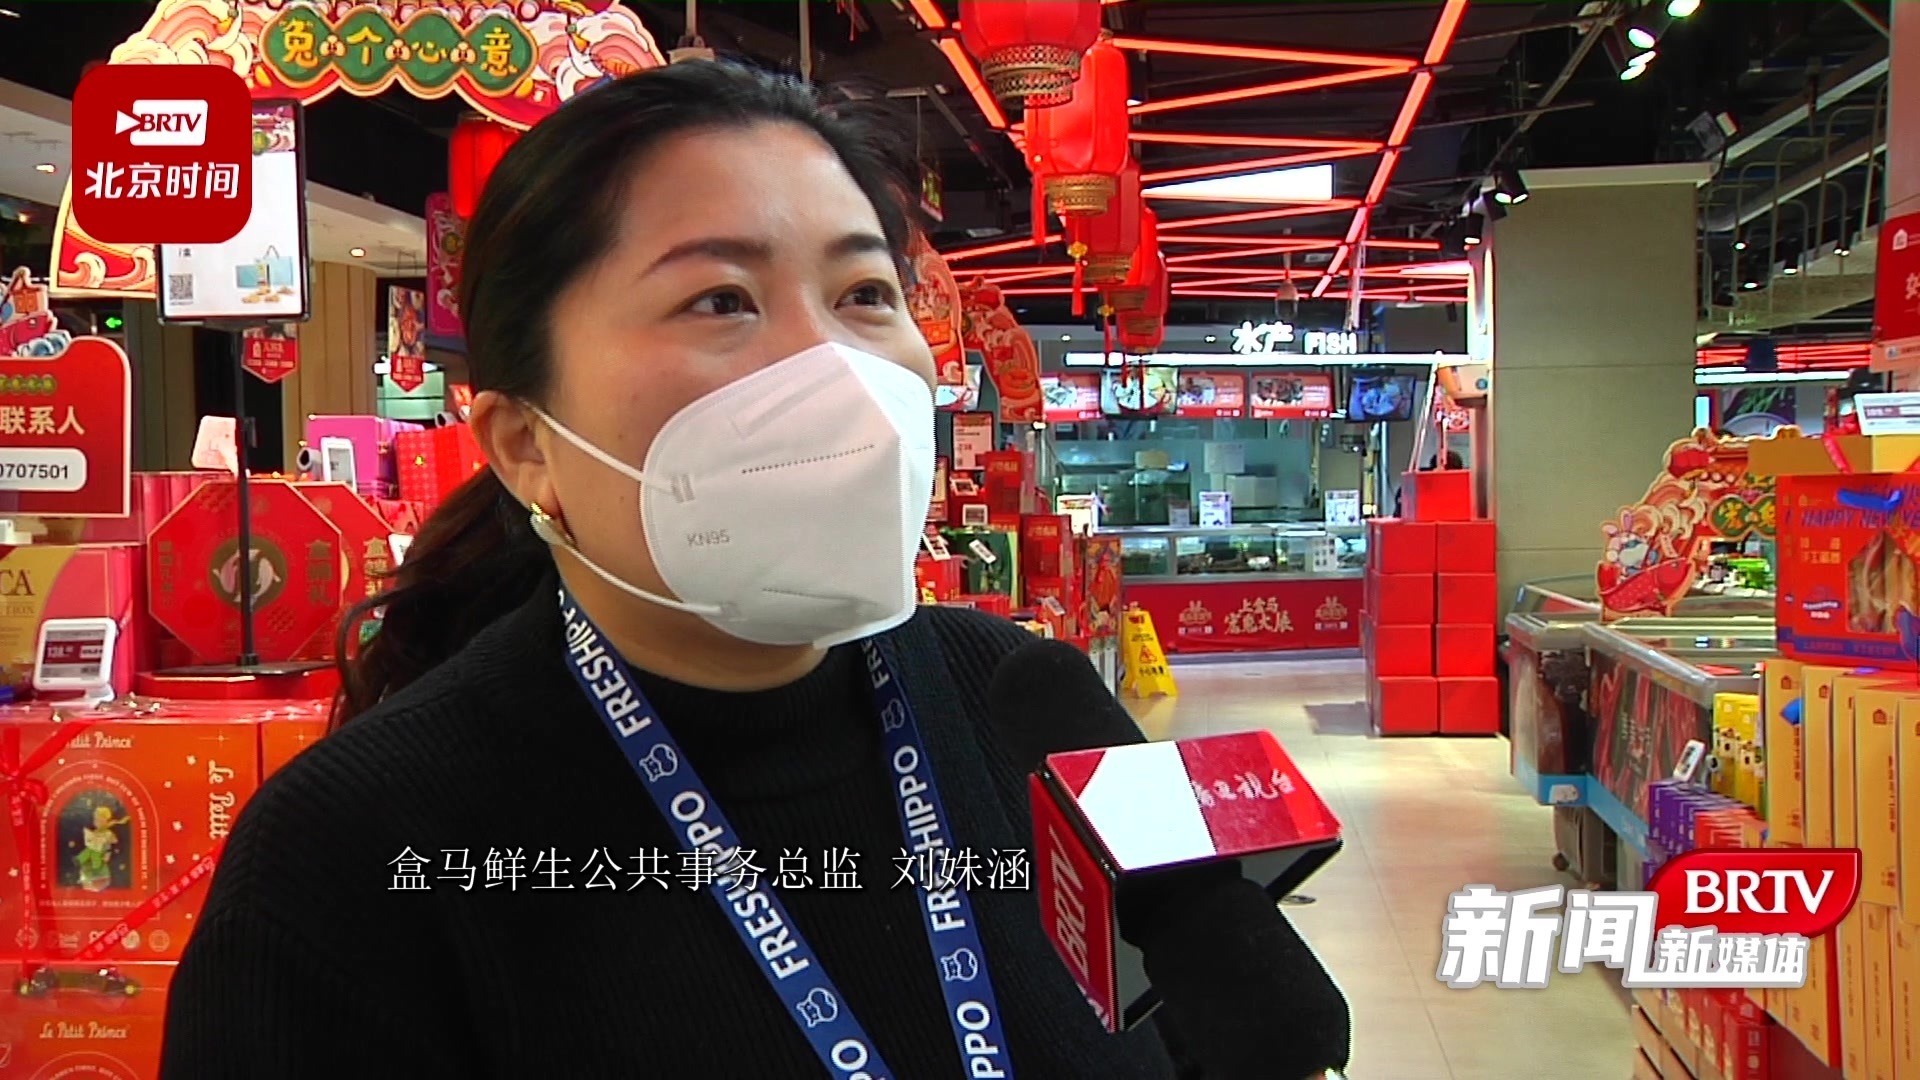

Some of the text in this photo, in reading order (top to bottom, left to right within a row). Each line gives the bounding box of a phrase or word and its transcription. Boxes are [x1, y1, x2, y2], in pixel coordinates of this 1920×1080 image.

[1232, 320, 1294, 353] 水产
[1304, 332, 1357, 354] FISH
[0, 405, 85, 434] 联系人
[687, 529, 731, 547] KN95
[1049, 823, 1090, 980] BRTV
